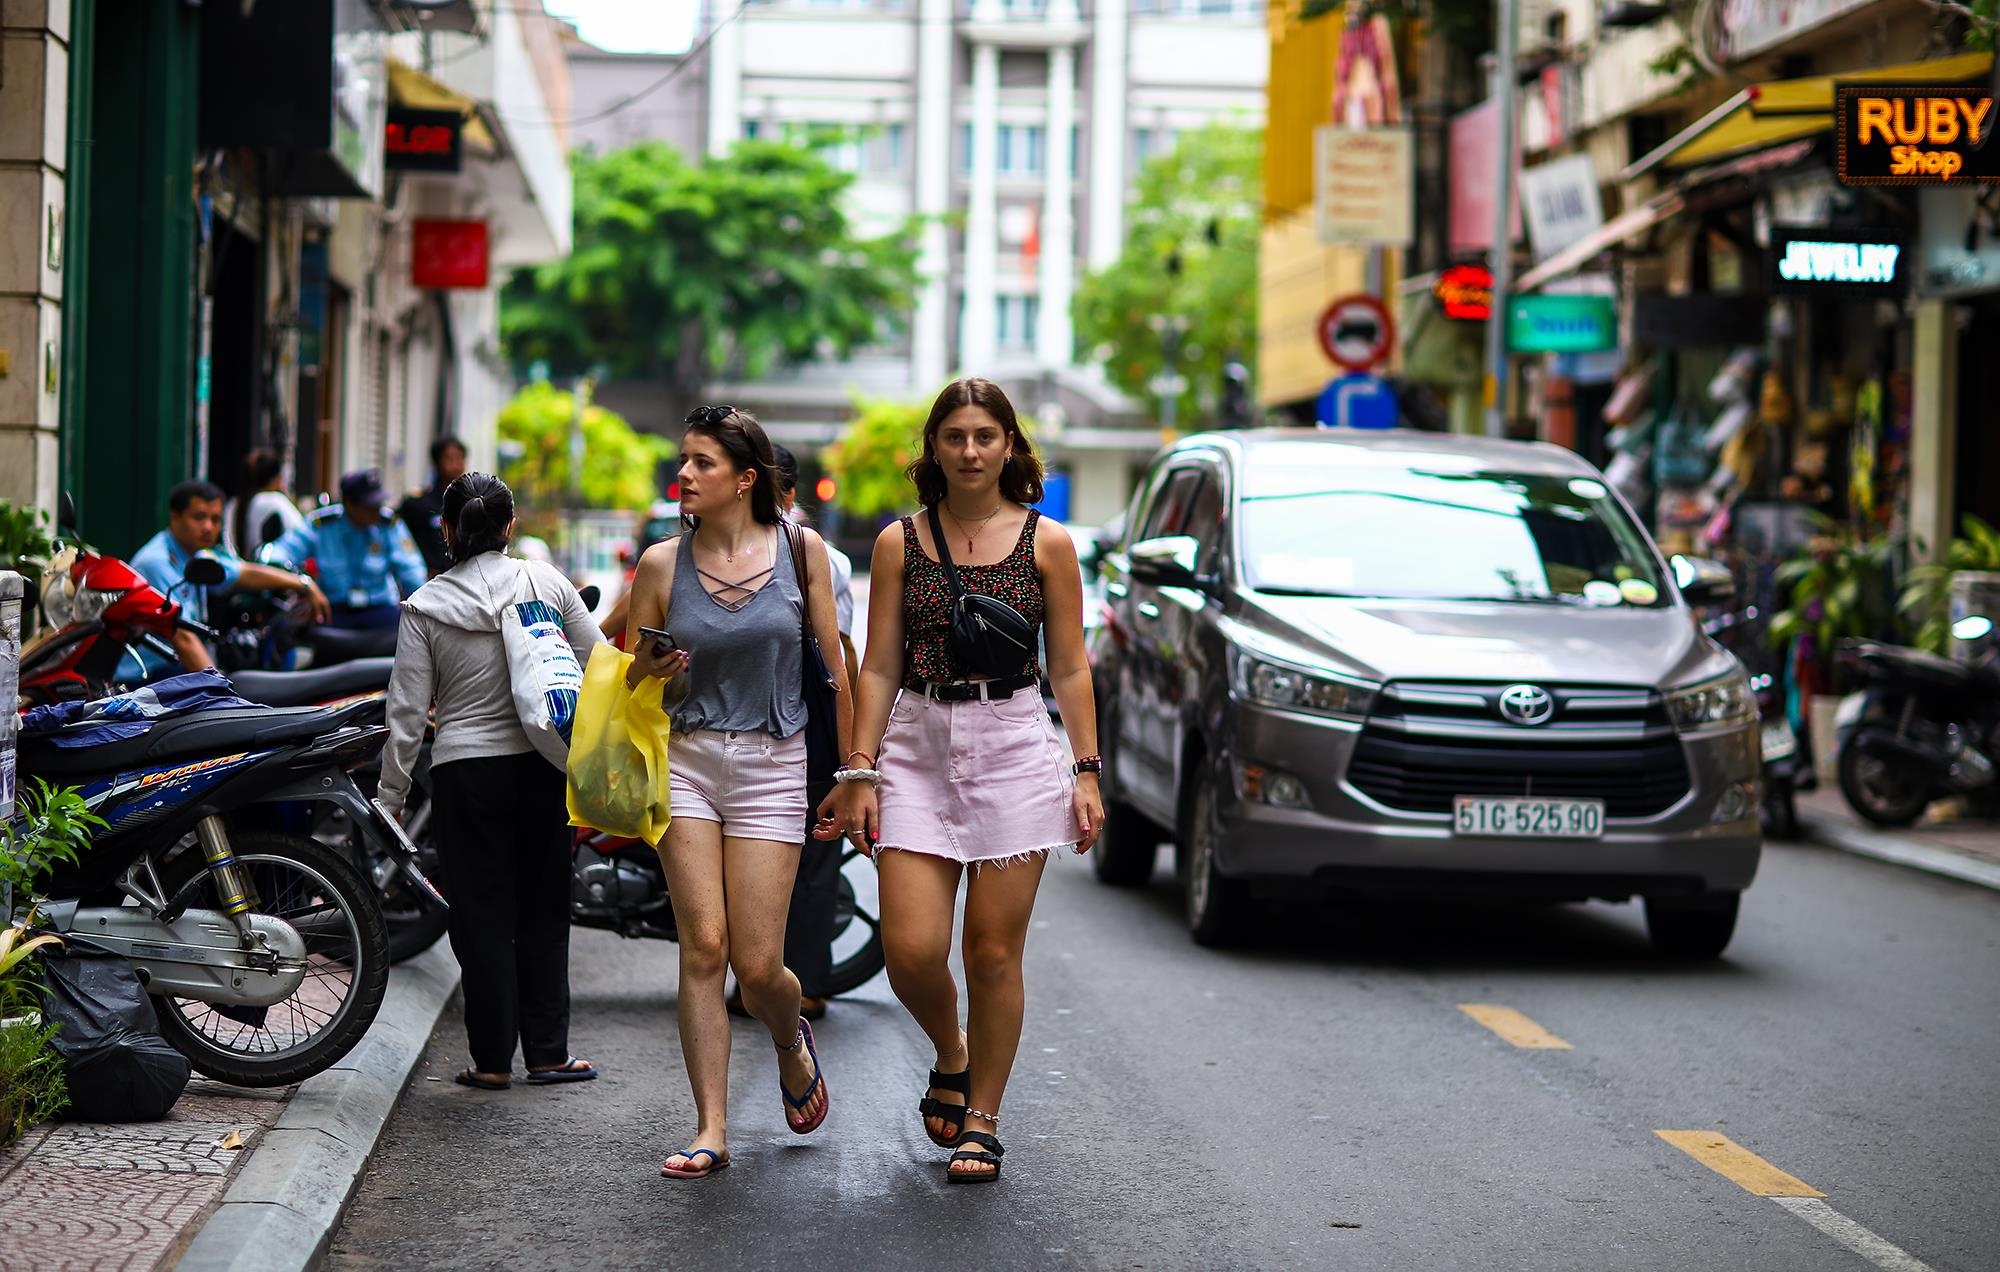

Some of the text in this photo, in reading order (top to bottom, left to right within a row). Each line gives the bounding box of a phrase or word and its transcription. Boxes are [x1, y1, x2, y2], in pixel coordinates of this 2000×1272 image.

[1857, 97, 1993, 145] RUBY
[1889, 145, 1963, 181] Shop
[1779, 241, 1900, 282] JEWELRY
